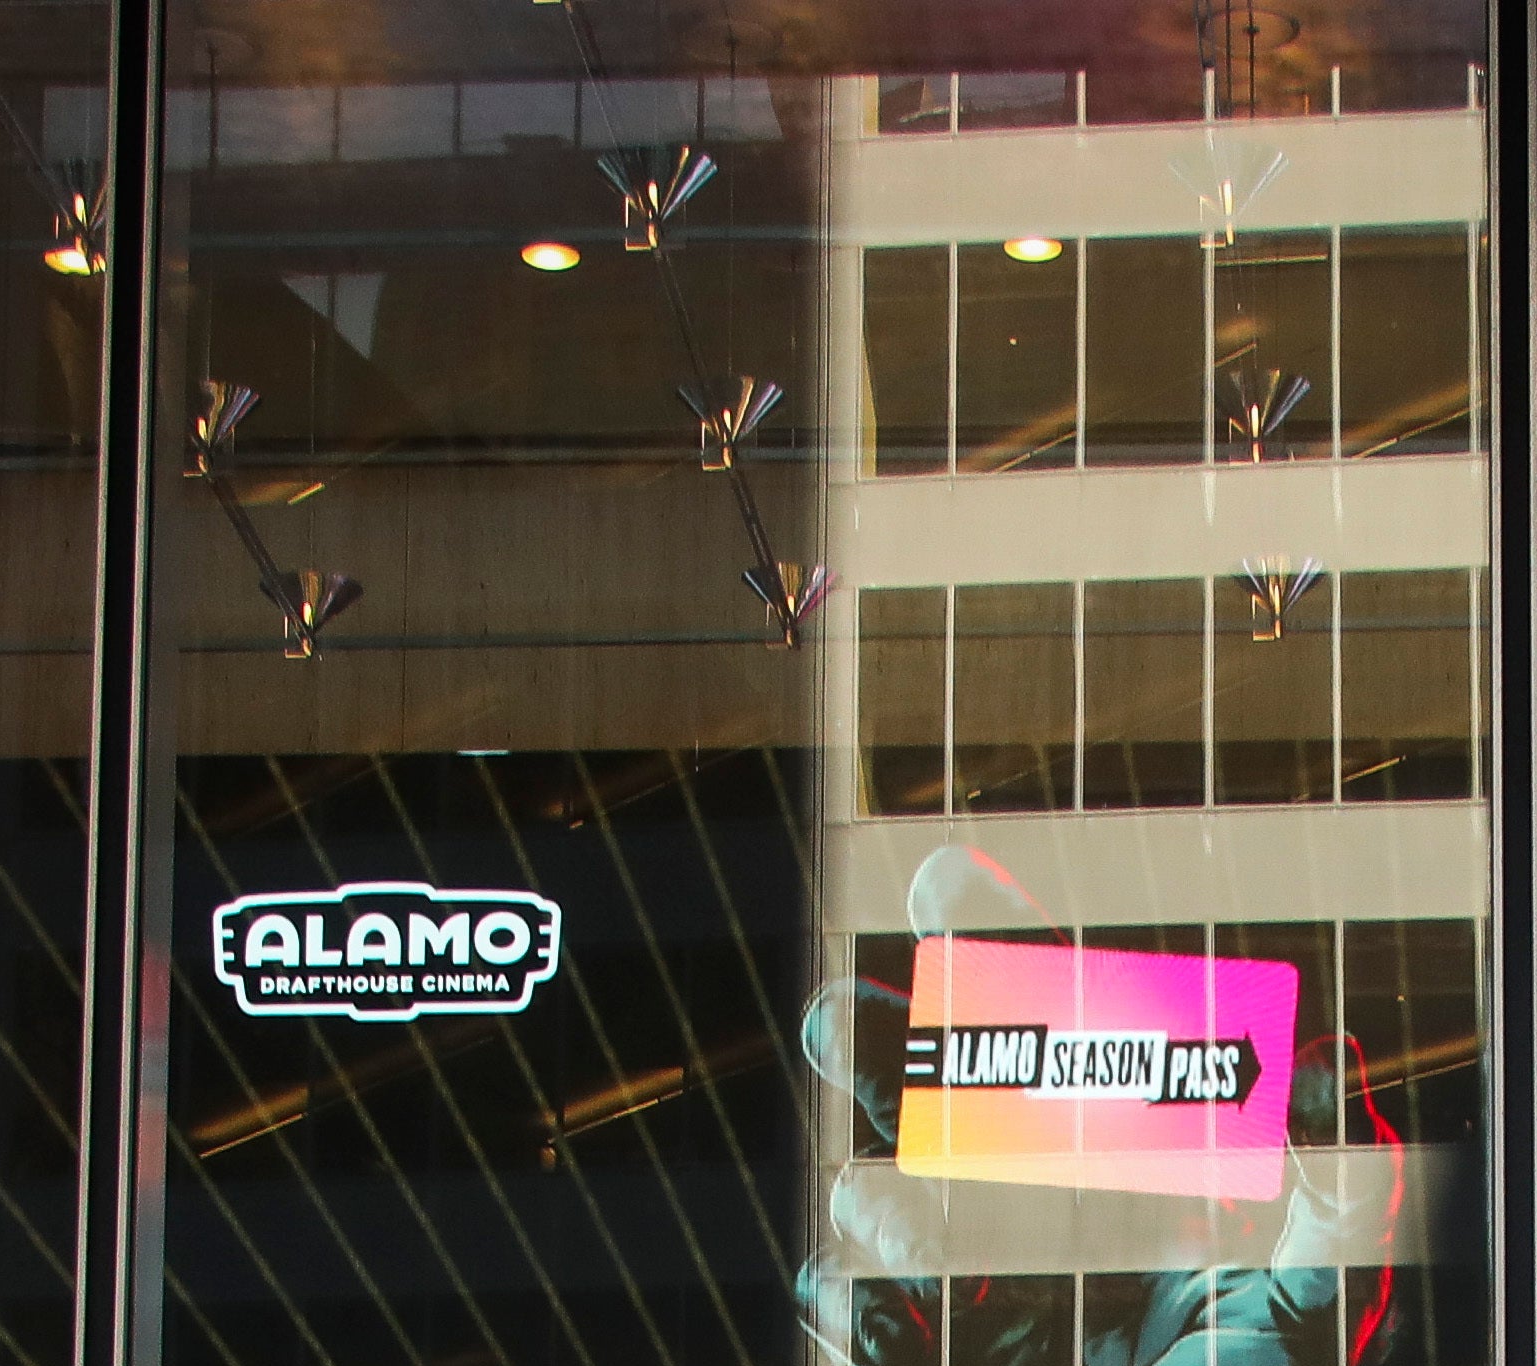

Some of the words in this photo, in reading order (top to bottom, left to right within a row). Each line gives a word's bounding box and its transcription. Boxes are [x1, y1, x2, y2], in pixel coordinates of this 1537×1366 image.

[245, 911, 531, 968] ALAMO
[261, 976, 413, 994] DRAFTHOUSE
[422, 974, 509, 992] CINEMA
[942, 1031, 1038, 1085] ALAMO
[1050, 1038, 1156, 1089] SEASON
[1168, 1046, 1241, 1100] PASS
